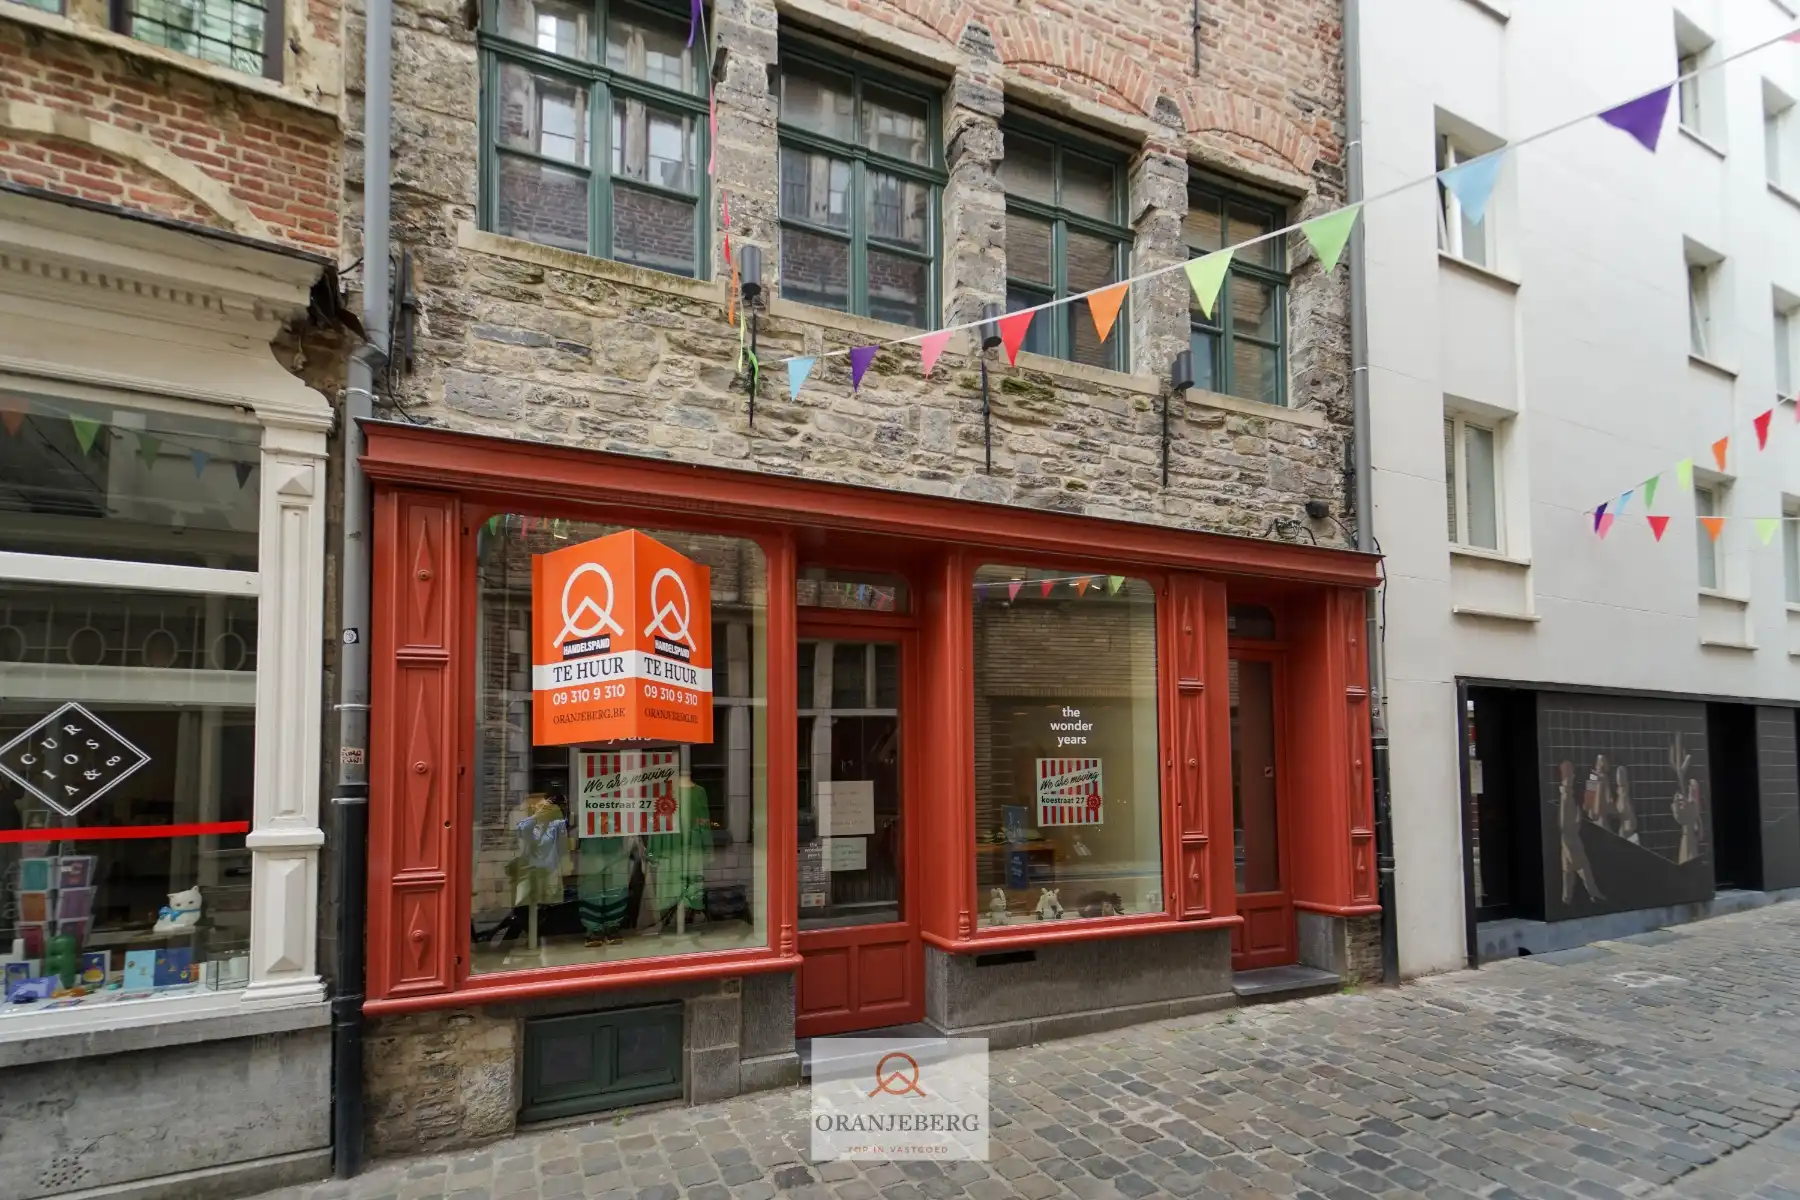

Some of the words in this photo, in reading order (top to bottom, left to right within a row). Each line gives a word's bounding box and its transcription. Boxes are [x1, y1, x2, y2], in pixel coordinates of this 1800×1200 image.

[563, 638, 610, 656] HANDELSPAND
[553, 664, 573, 683] TE
[577, 657, 625, 679] HUUR
[644, 657, 661, 677] TE
[665, 661, 698, 685] HUUR
[552, 692, 567, 705] 09
[571, 688, 590, 703] 310
[593, 687, 601, 700] 9
[604, 684, 625, 699] 310
[644, 685, 658, 698] 09
[660, 688, 675, 701] 310
[677, 691, 683, 703] 9
[685, 694, 698, 706] 310
[553, 708, 626, 725] ORANJEBERG.BE
[1062, 706, 1080, 717] the
[1050, 720, 1093, 731] wonder
[1057, 735, 1087, 747] years
[584, 780, 604, 793] We
[606, 774, 627, 789] are
[631, 768, 675, 783] moving
[1040, 779, 1053, 791] We
[1070, 770, 1099, 784] moving
[585, 800, 636, 809] koestraat
[639, 800, 652, 809] 27
[1041, 796, 1074, 804] koestraat
